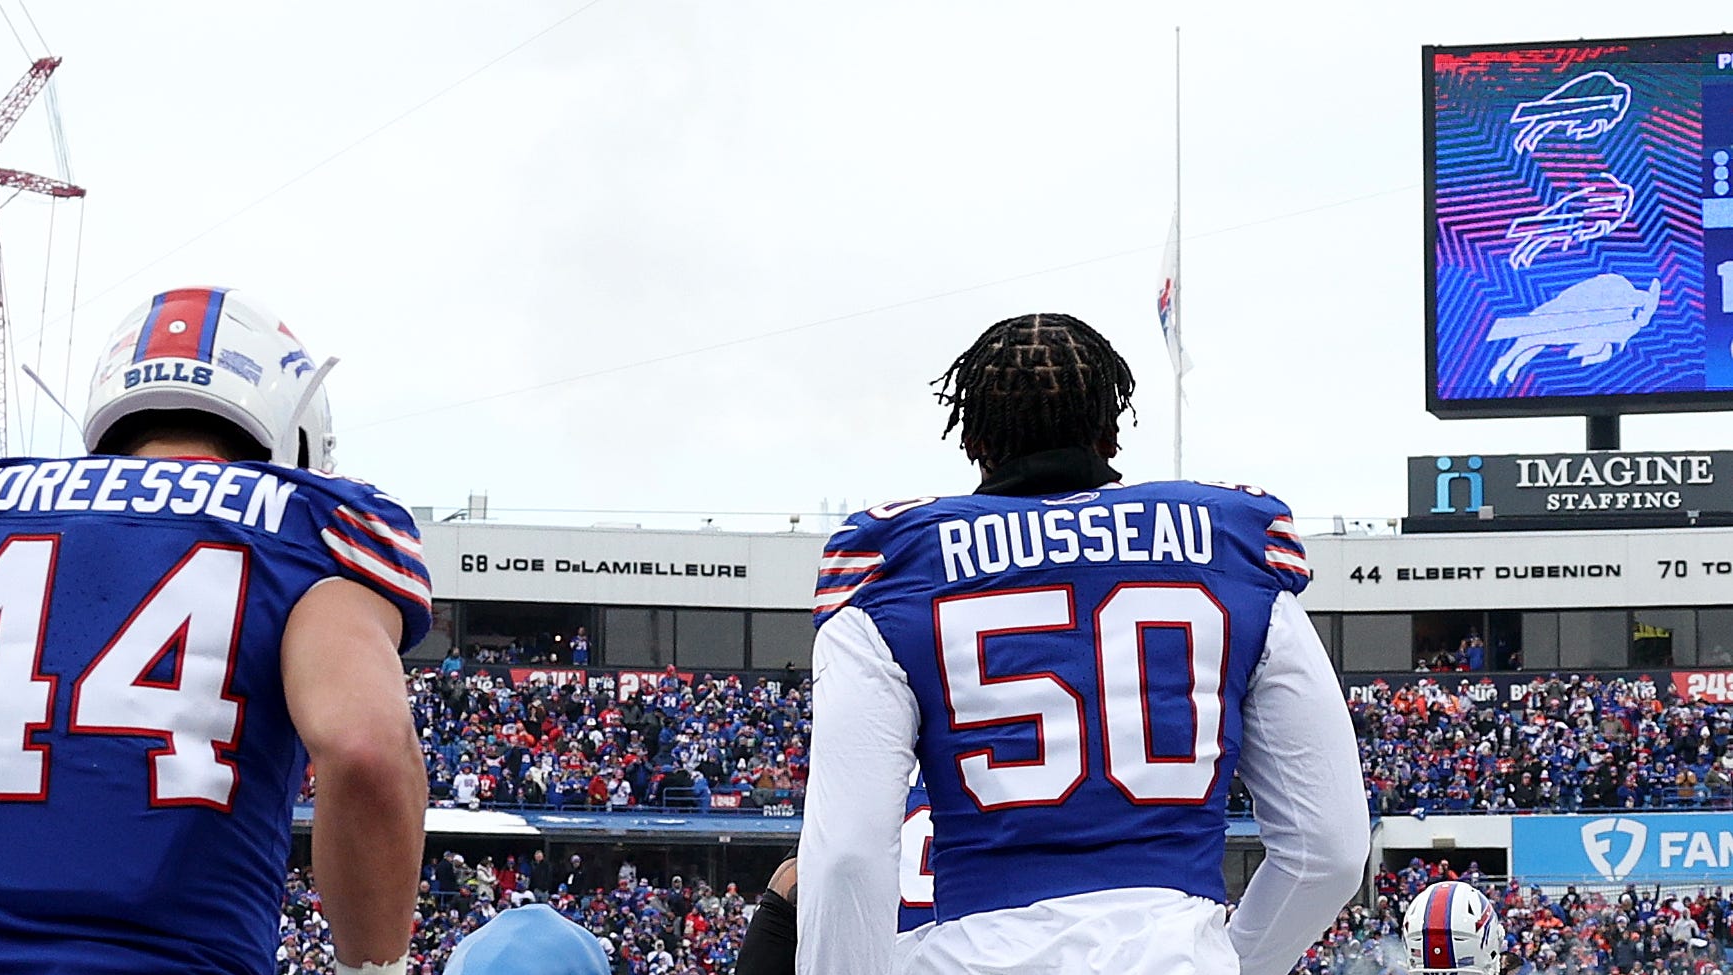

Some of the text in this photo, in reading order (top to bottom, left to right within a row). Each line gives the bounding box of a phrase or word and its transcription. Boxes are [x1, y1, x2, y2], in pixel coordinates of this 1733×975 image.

[124, 363, 213, 389] BILLS
[1515, 455, 1714, 488] IMAGINE
[1546, 491, 1682, 511] STAFFING
[938, 501, 1213, 583] ROUSSEAU
[461, 554, 488, 573] 68
[496, 557, 544, 572] JOE
[1350, 566, 1382, 584] 44
[1397, 565, 1485, 581] ELBERT
[1496, 563, 1622, 579] DUBENION
[1657, 560, 1687, 579] 70
[933, 581, 1230, 812] 50
